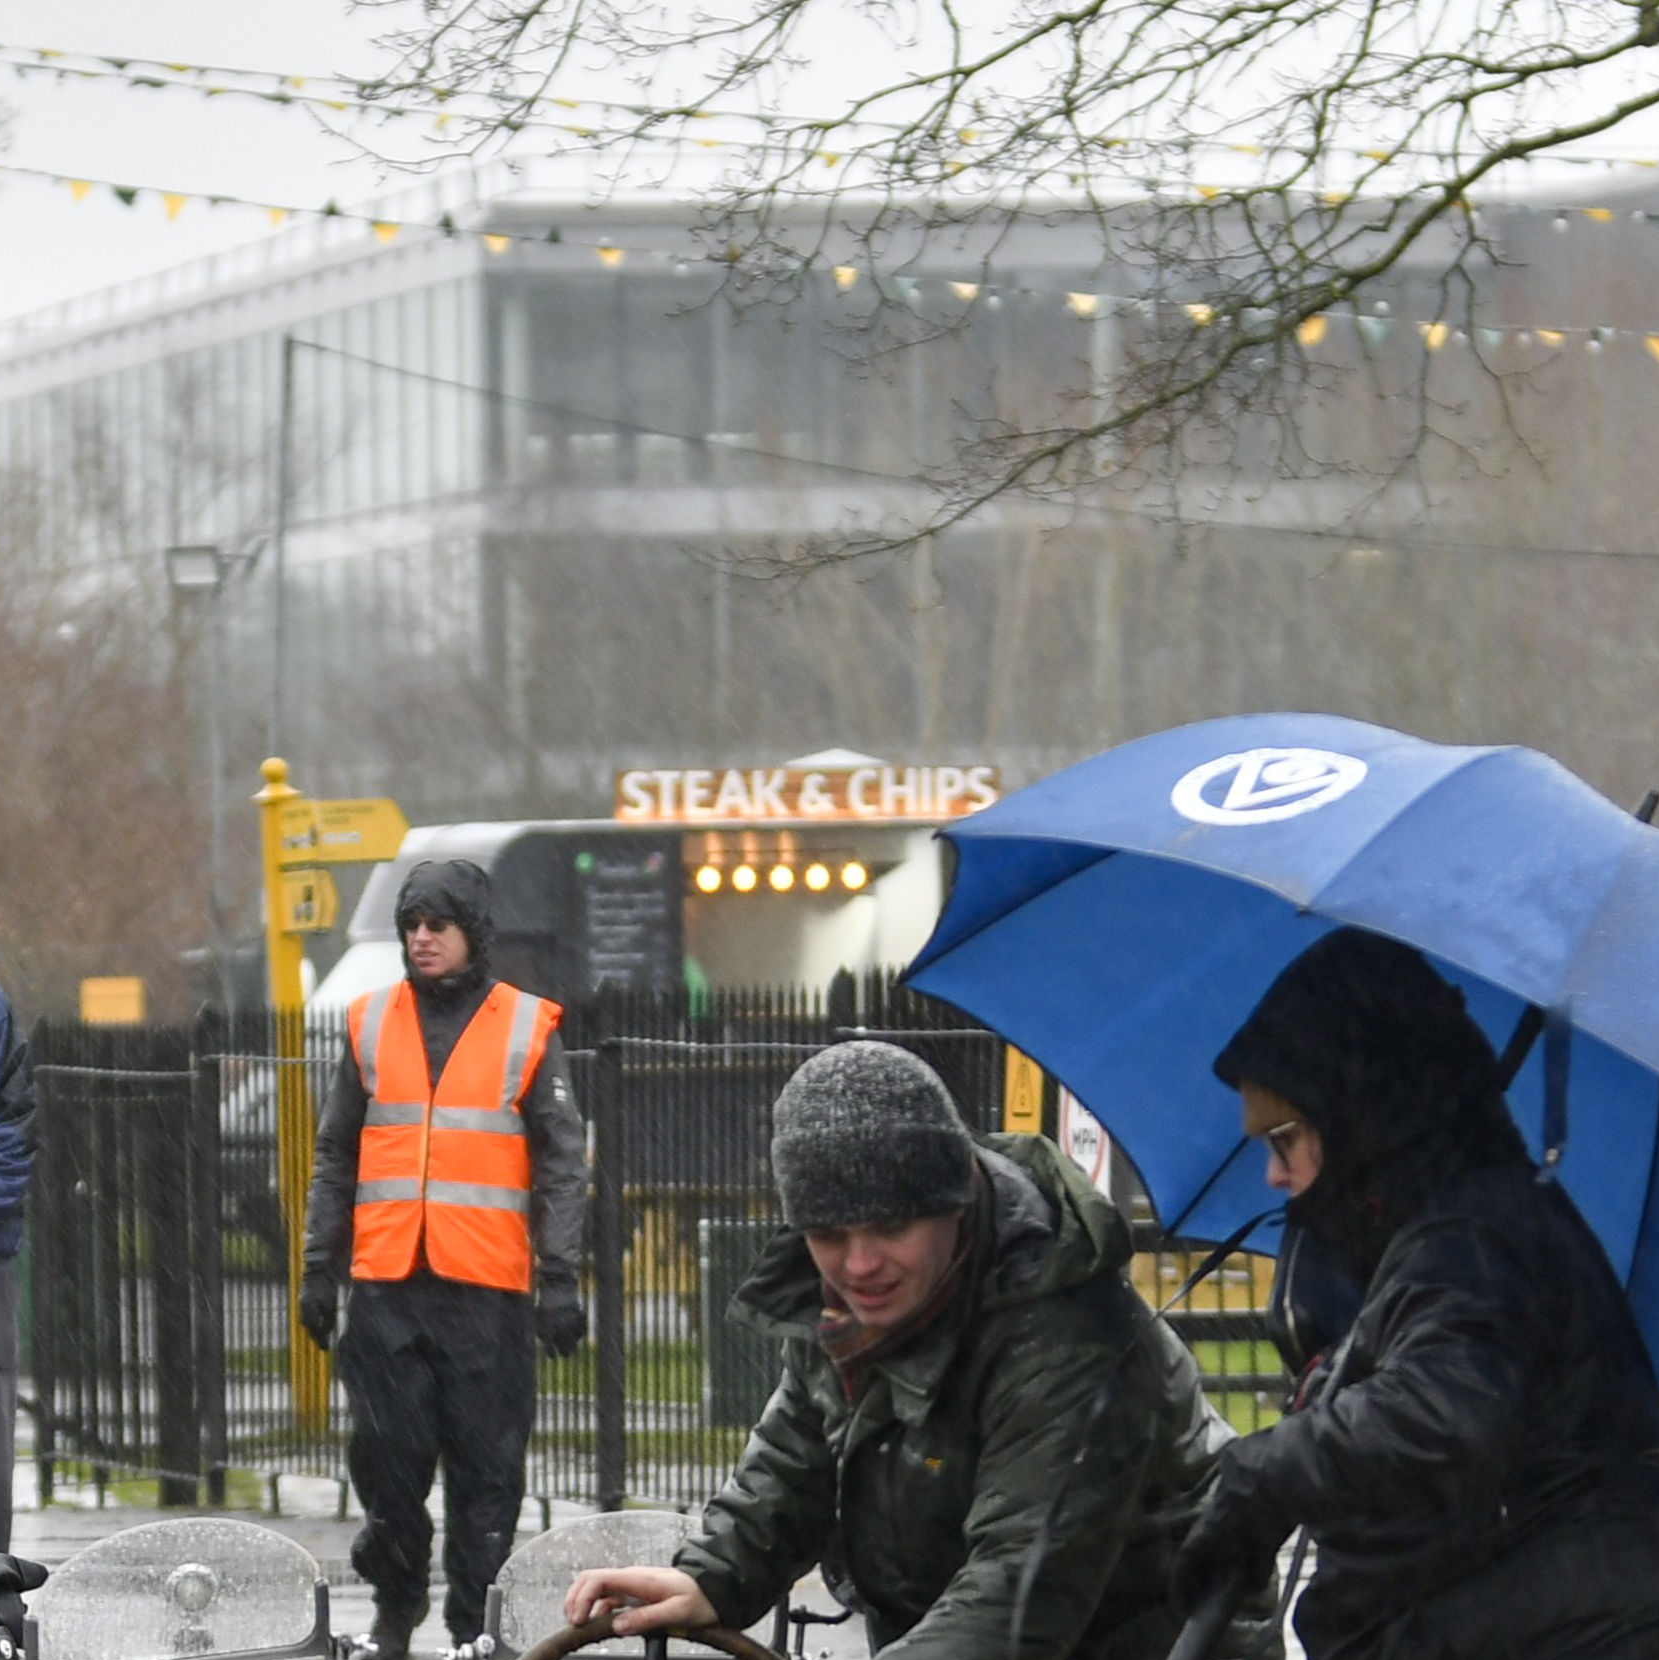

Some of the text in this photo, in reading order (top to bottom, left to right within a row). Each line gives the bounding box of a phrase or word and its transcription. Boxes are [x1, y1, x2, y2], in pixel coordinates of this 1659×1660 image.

[621, 766, 998, 818] STEAK & CHIPS
[1072, 1127, 1098, 1154] MPH
